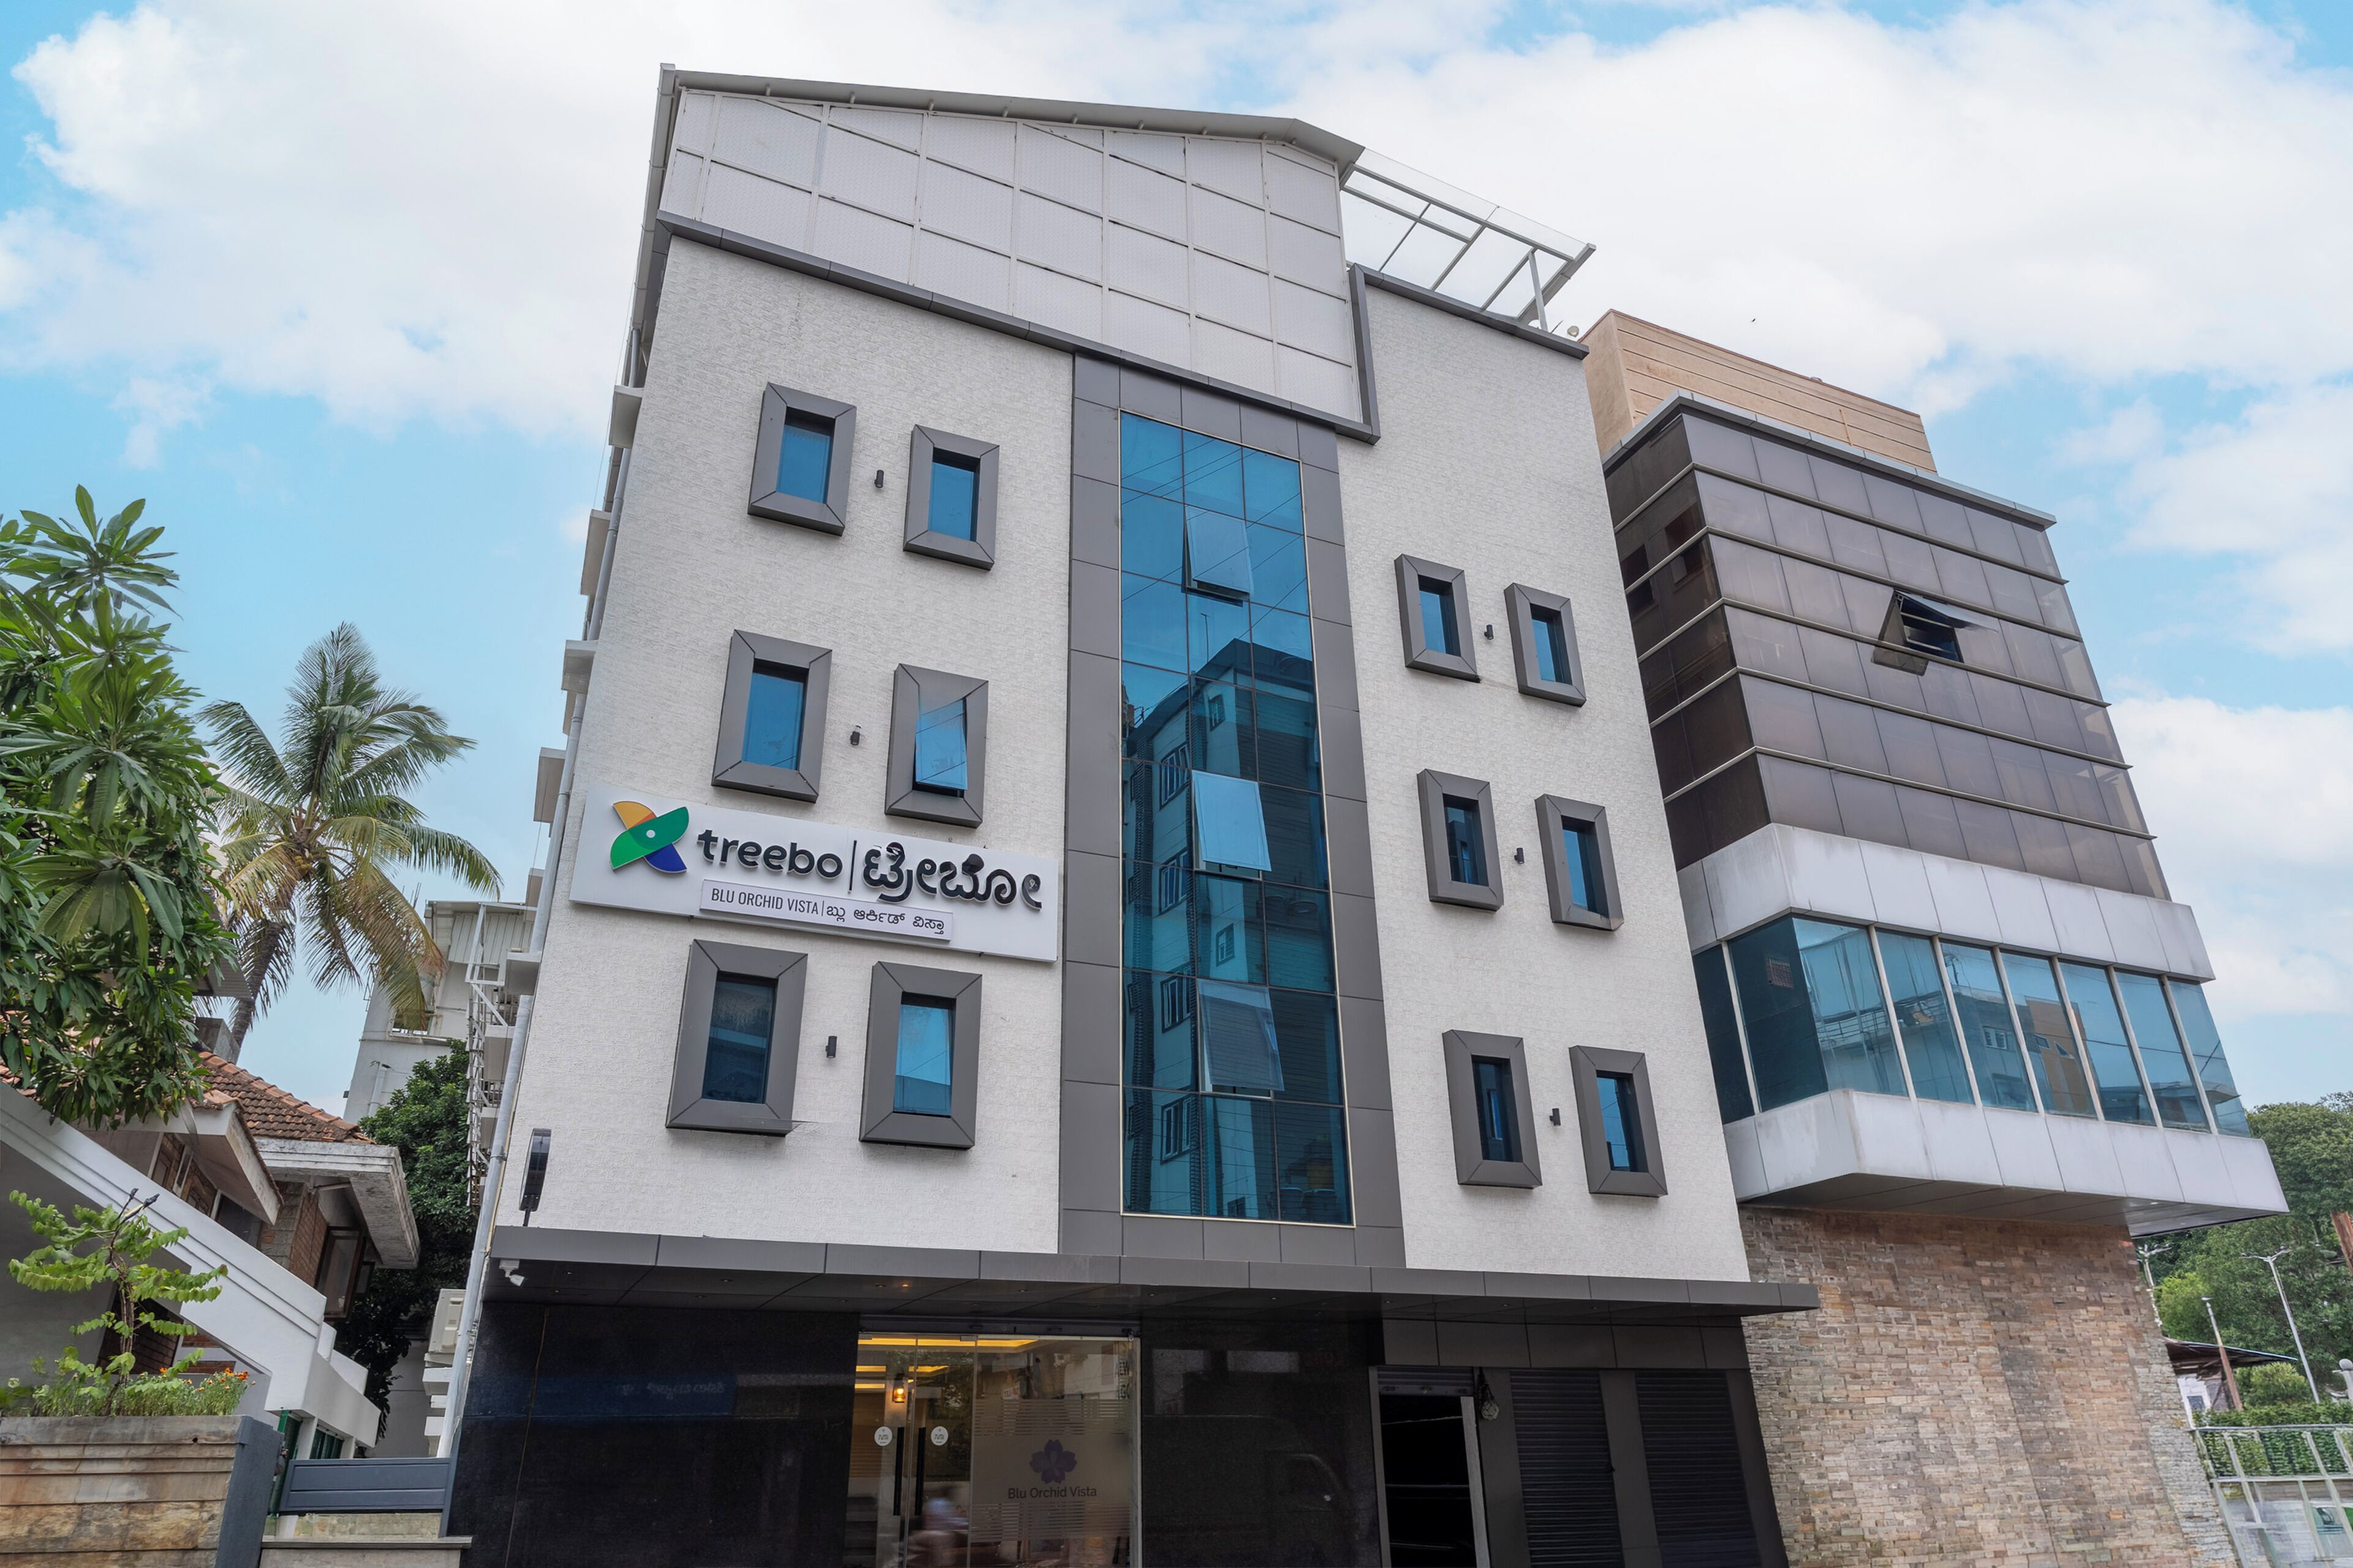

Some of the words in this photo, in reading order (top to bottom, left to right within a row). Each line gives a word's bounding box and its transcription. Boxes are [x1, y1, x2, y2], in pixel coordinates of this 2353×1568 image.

[697, 829, 843, 879] treebo
[862, 842, 1043, 910] ಟ್ರೀಬೋ
[711, 888, 735, 903] BLU
[738, 891, 783, 910] ORCHID
[787, 898, 819, 915] VISTA
[1008, 1488, 1026, 1499] Blu
[1030, 1487, 1067, 1498] Orchid
[1069, 1487, 1097, 1497] Vista
